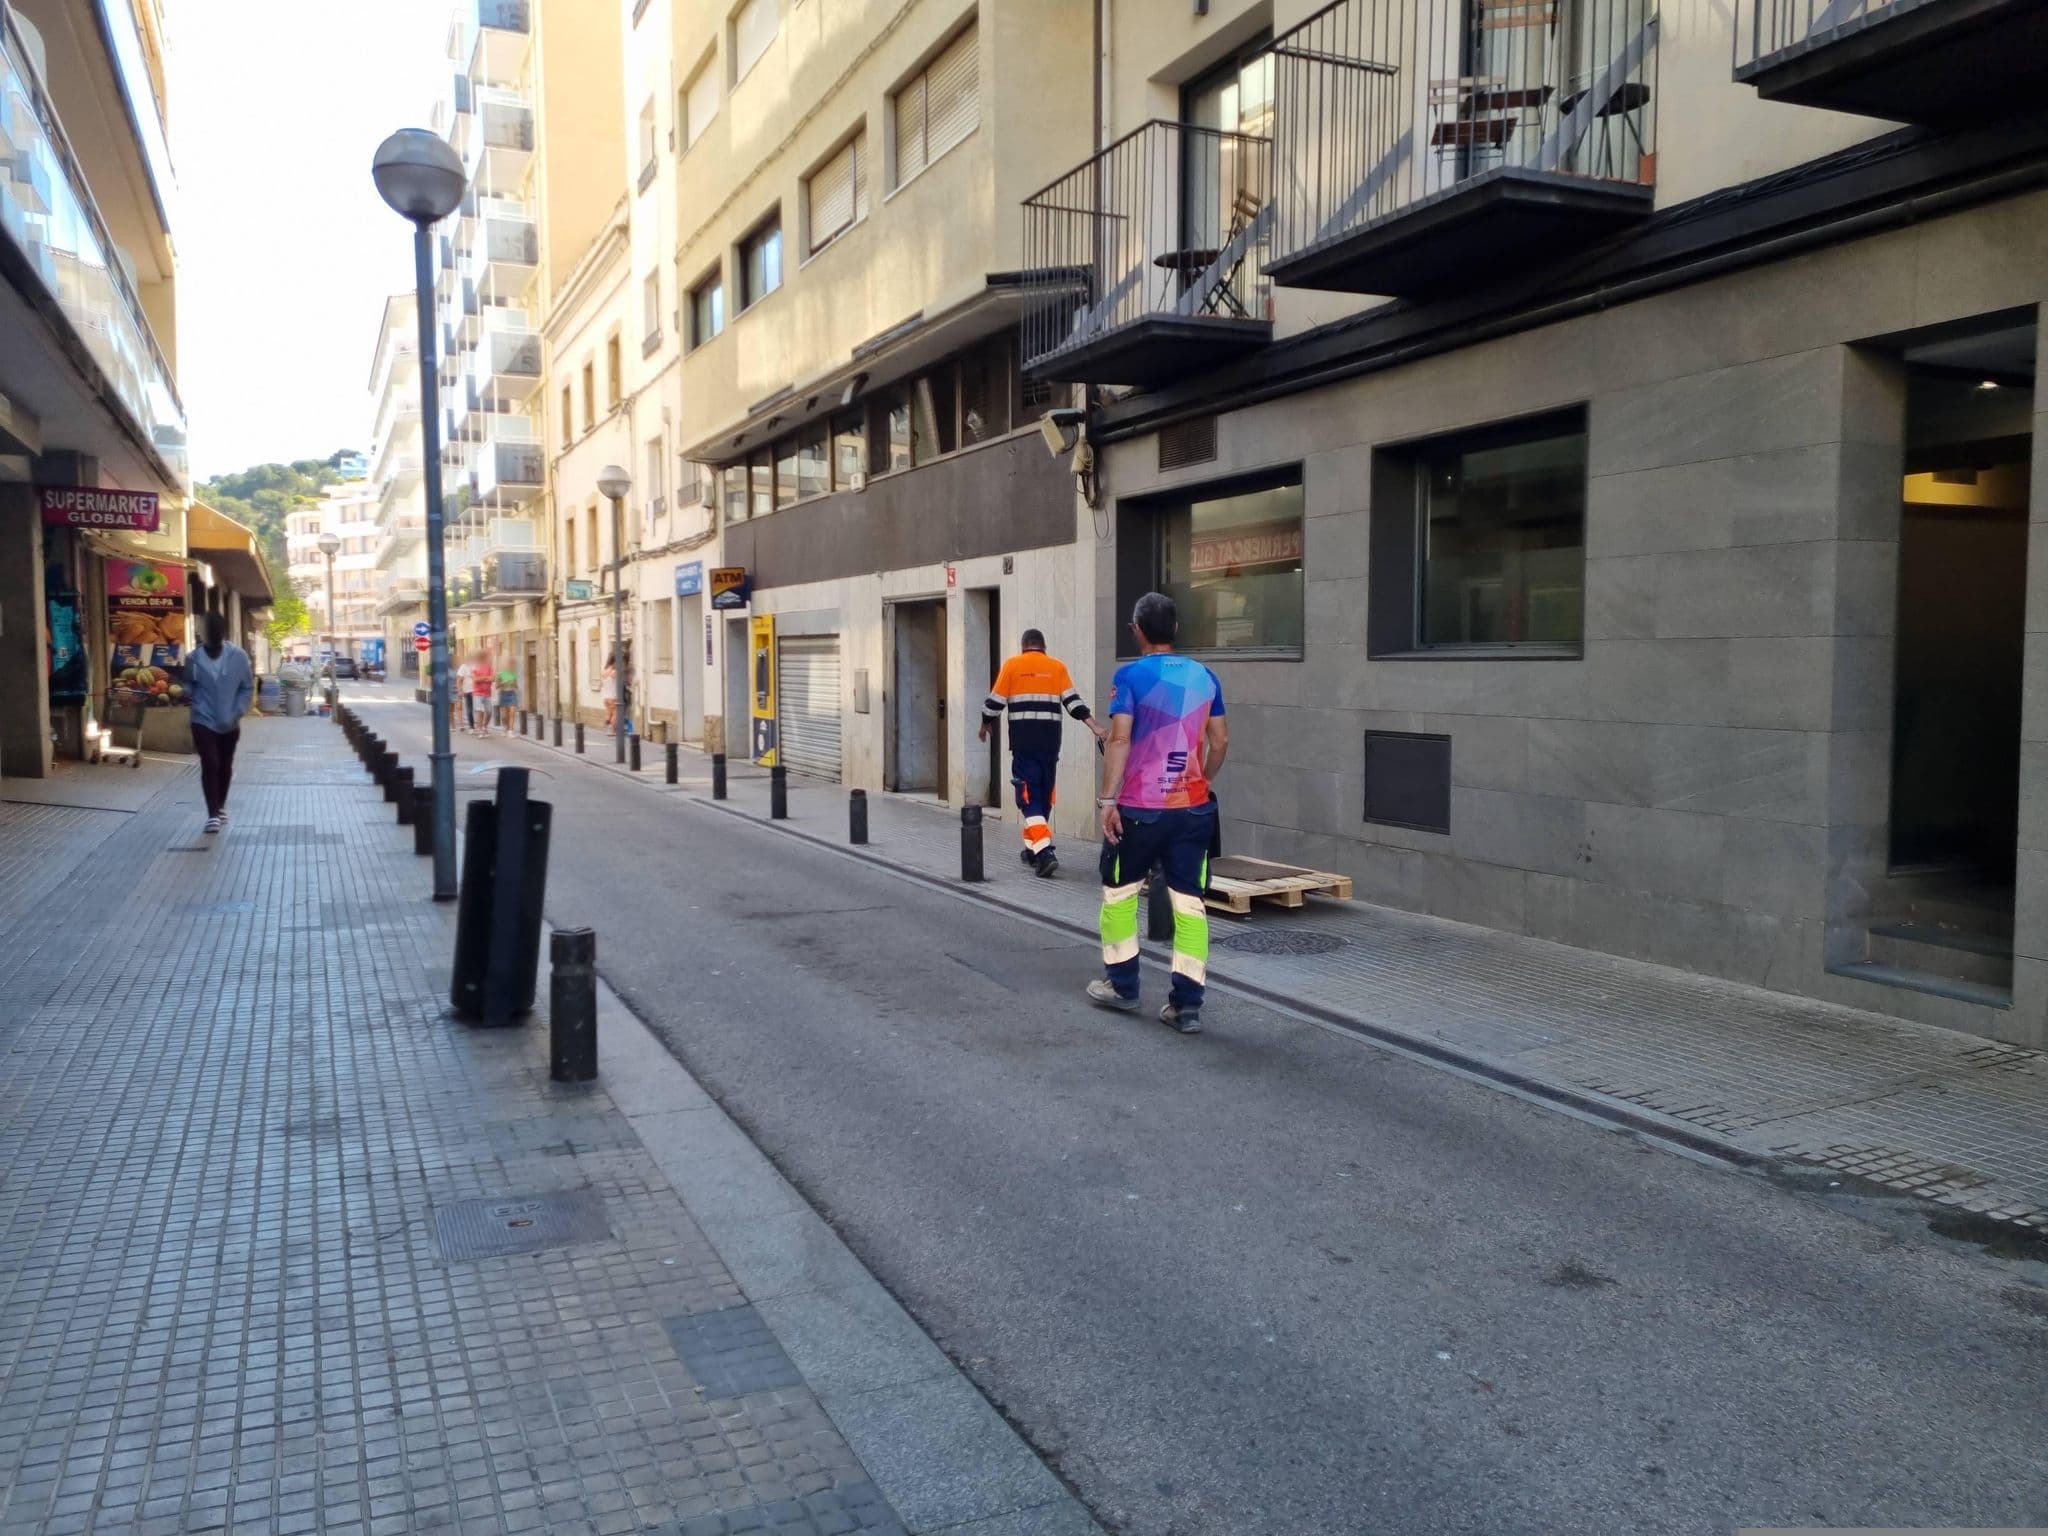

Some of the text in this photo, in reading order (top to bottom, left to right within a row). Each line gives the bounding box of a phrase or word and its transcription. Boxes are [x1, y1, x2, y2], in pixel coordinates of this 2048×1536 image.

[45, 489, 157, 515] SUPERMARKET
[67, 511, 138, 526] GLOBAL
[714, 573, 743, 584] ATM
